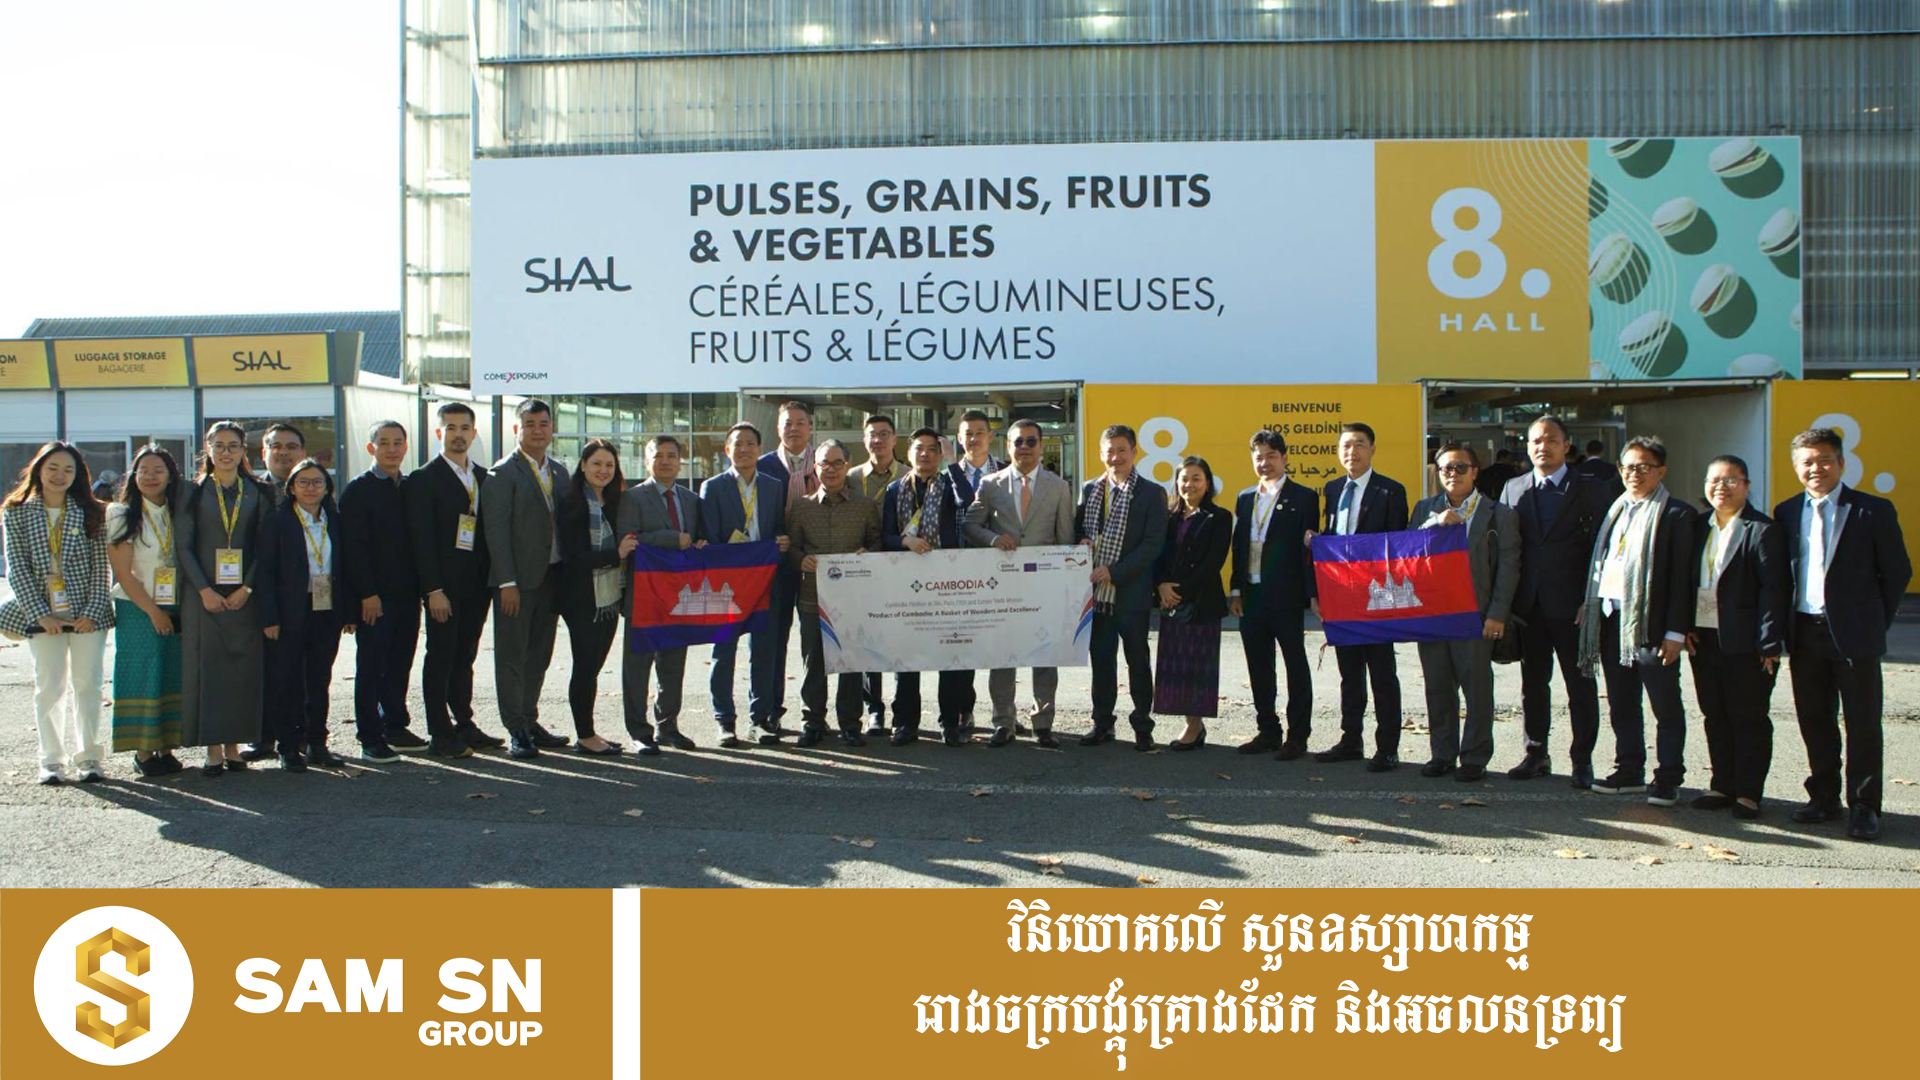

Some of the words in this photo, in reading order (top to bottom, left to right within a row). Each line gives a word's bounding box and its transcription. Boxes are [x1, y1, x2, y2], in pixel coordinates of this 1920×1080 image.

[690, 180, 852, 220] PULSES,
[866, 176, 1052, 216] GRAINS,
[1067, 173, 1211, 209] FRUITS
[689, 229, 720, 263] &
[732, 224, 995, 262] VEGETABLES
[524, 256, 632, 294] SIAL
[689, 274, 883, 321] CÉRÉALES,
[900, 271, 1225, 317] LÉGUMINEUSES,
[1439, 312, 1546, 332] HALL
[691, 329, 812, 364] FRUITS
[825, 328, 853, 363] &
[867, 317, 1056, 362] LÉGUMES
[75, 353, 119, 362] LUGGAGE
[122, 352, 167, 361] STORAGE
[232, 350, 291, 372] SIAL
[98, 363, 145, 374] BAGAGERIE
[484, 372, 548, 384] COMEXPOSIUM
[1271, 402, 1342, 413] BIENVENUE
[1293, 421, 1347, 434] GELDİNİ
[1300, 462, 1337, 478] مرحبا
[925, 579, 985, 591] CAMBODIA
